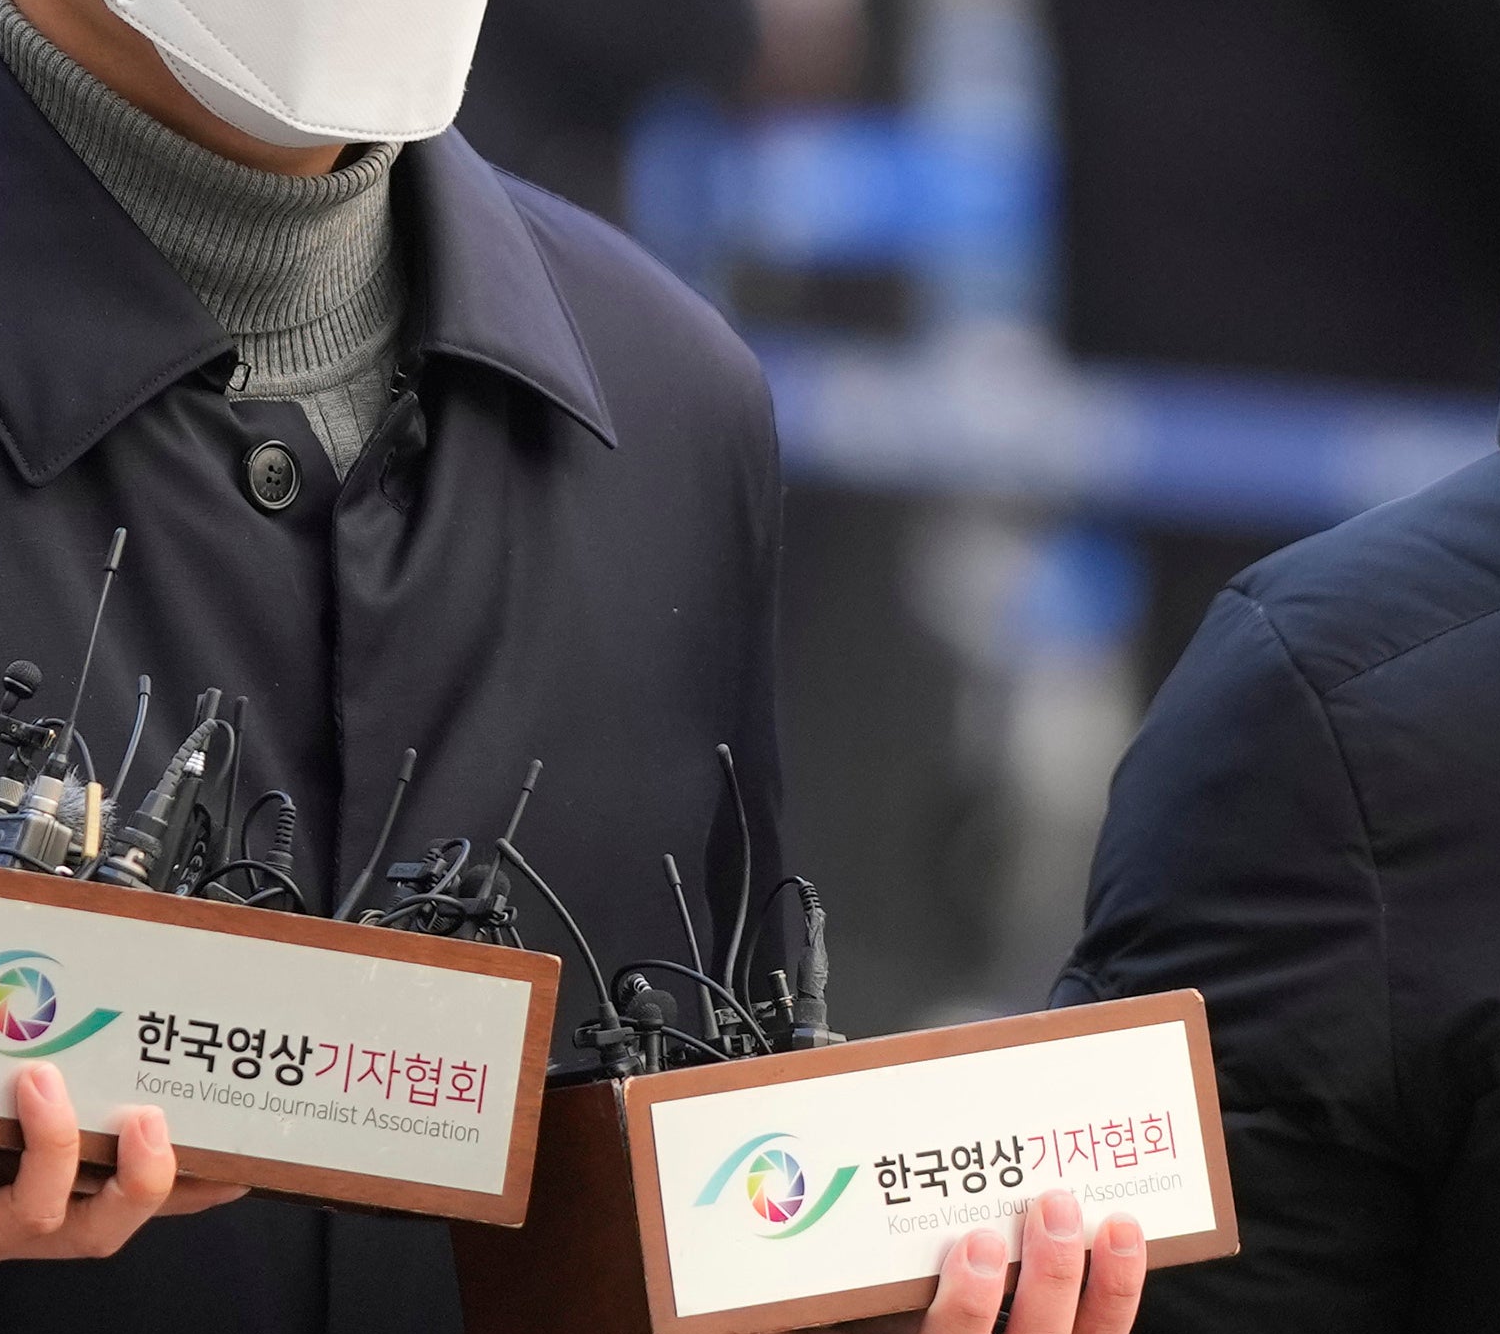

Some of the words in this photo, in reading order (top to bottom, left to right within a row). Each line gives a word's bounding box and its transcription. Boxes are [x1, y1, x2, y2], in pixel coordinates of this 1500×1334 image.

[137, 1010, 488, 1114] 한국영상기자협회
[135, 1070, 194, 1099] Korea
[199, 1080, 256, 1109] Video
[258, 1091, 358, 1126] Journalist
[362, 1107, 480, 1144] Association
[873, 1110, 1177, 1205] 한국영상기자협회
[887, 1212, 939, 1235] Korea
[940, 1202, 990, 1226] Video
[1083, 1171, 1182, 1204] Association
